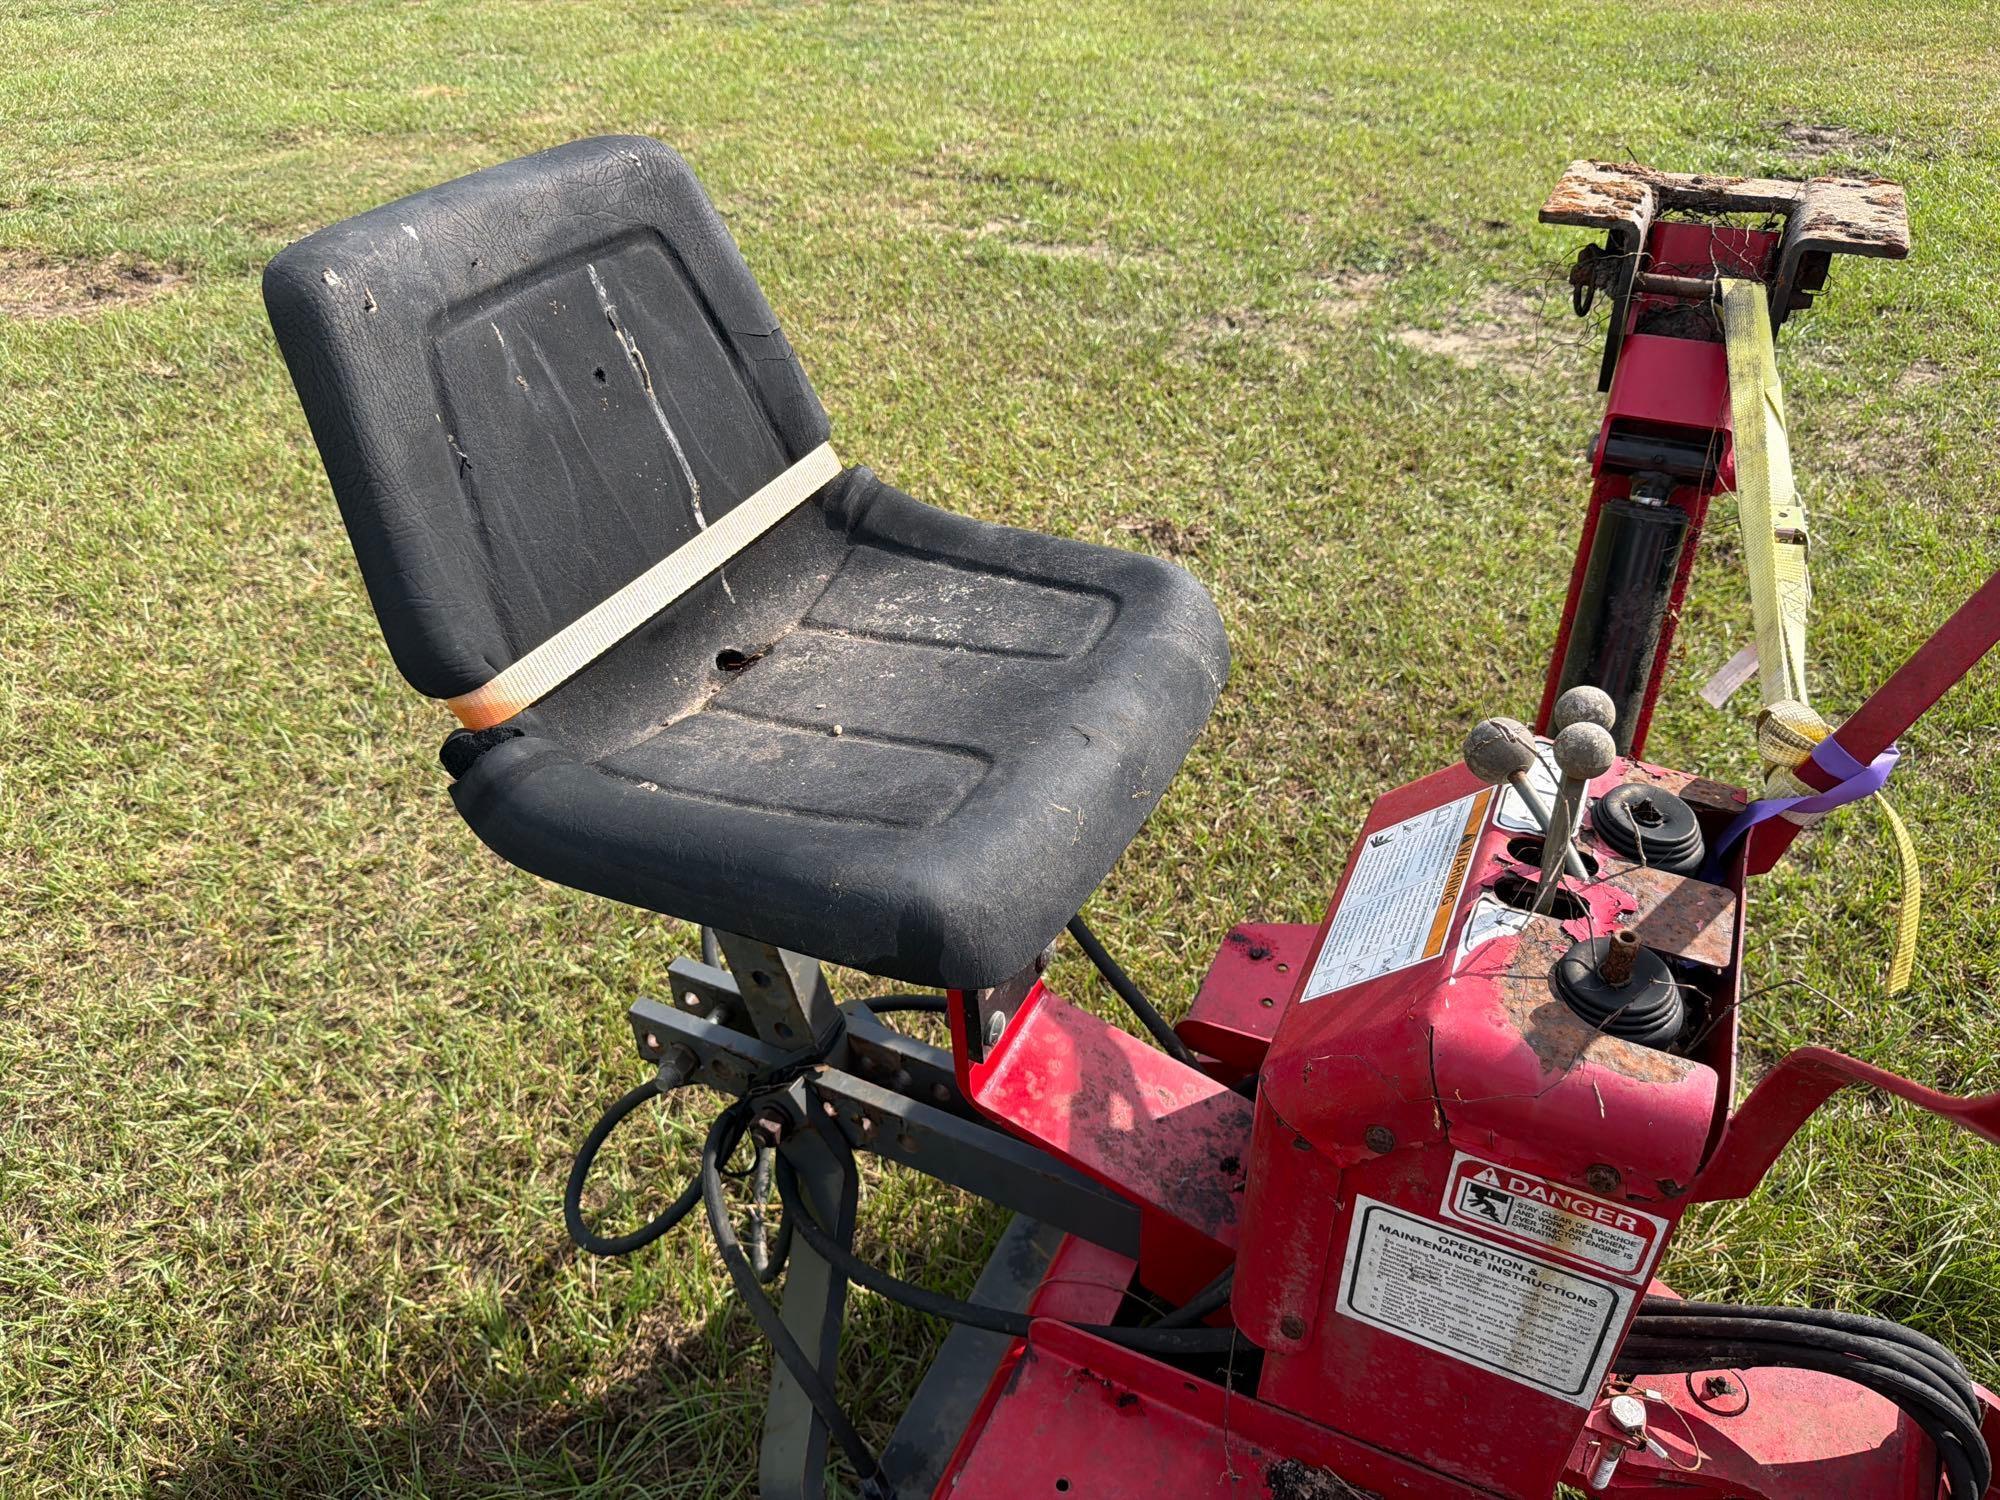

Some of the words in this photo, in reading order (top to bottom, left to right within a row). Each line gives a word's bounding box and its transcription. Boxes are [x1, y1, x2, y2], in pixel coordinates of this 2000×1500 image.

[1440, 843, 1472, 906] WARNING
[1507, 1176, 1638, 1231] DANGER
[1516, 1201, 1538, 1214] STAY
[1540, 1210, 1572, 1226] CLEAR
[1574, 1221, 1589, 1231] OF
[1590, 1227, 1638, 1248] BACKHOE
[1511, 1220, 1564, 1243] OPERATING.
[1512, 1214, 1537, 1227] EVER
[1539, 1223, 1582, 1243] TRACTOR
[1584, 1239, 1621, 1256] ENGINE
[1622, 1252, 1634, 1260] IS
[1514, 1208, 1534, 1220] AND
[1537, 1216, 1565, 1230] WORK
[1568, 1226, 1594, 1240] AREA
[1596, 1236, 1630, 1252] WHEN-
[1377, 1222, 1483, 1267] MAINTENANCE
[1486, 1261, 1599, 1308] INSTRUCTIONS
[1437, 1235, 1524, 1271] OPERATION
[1527, 1266, 1539, 1277] &
